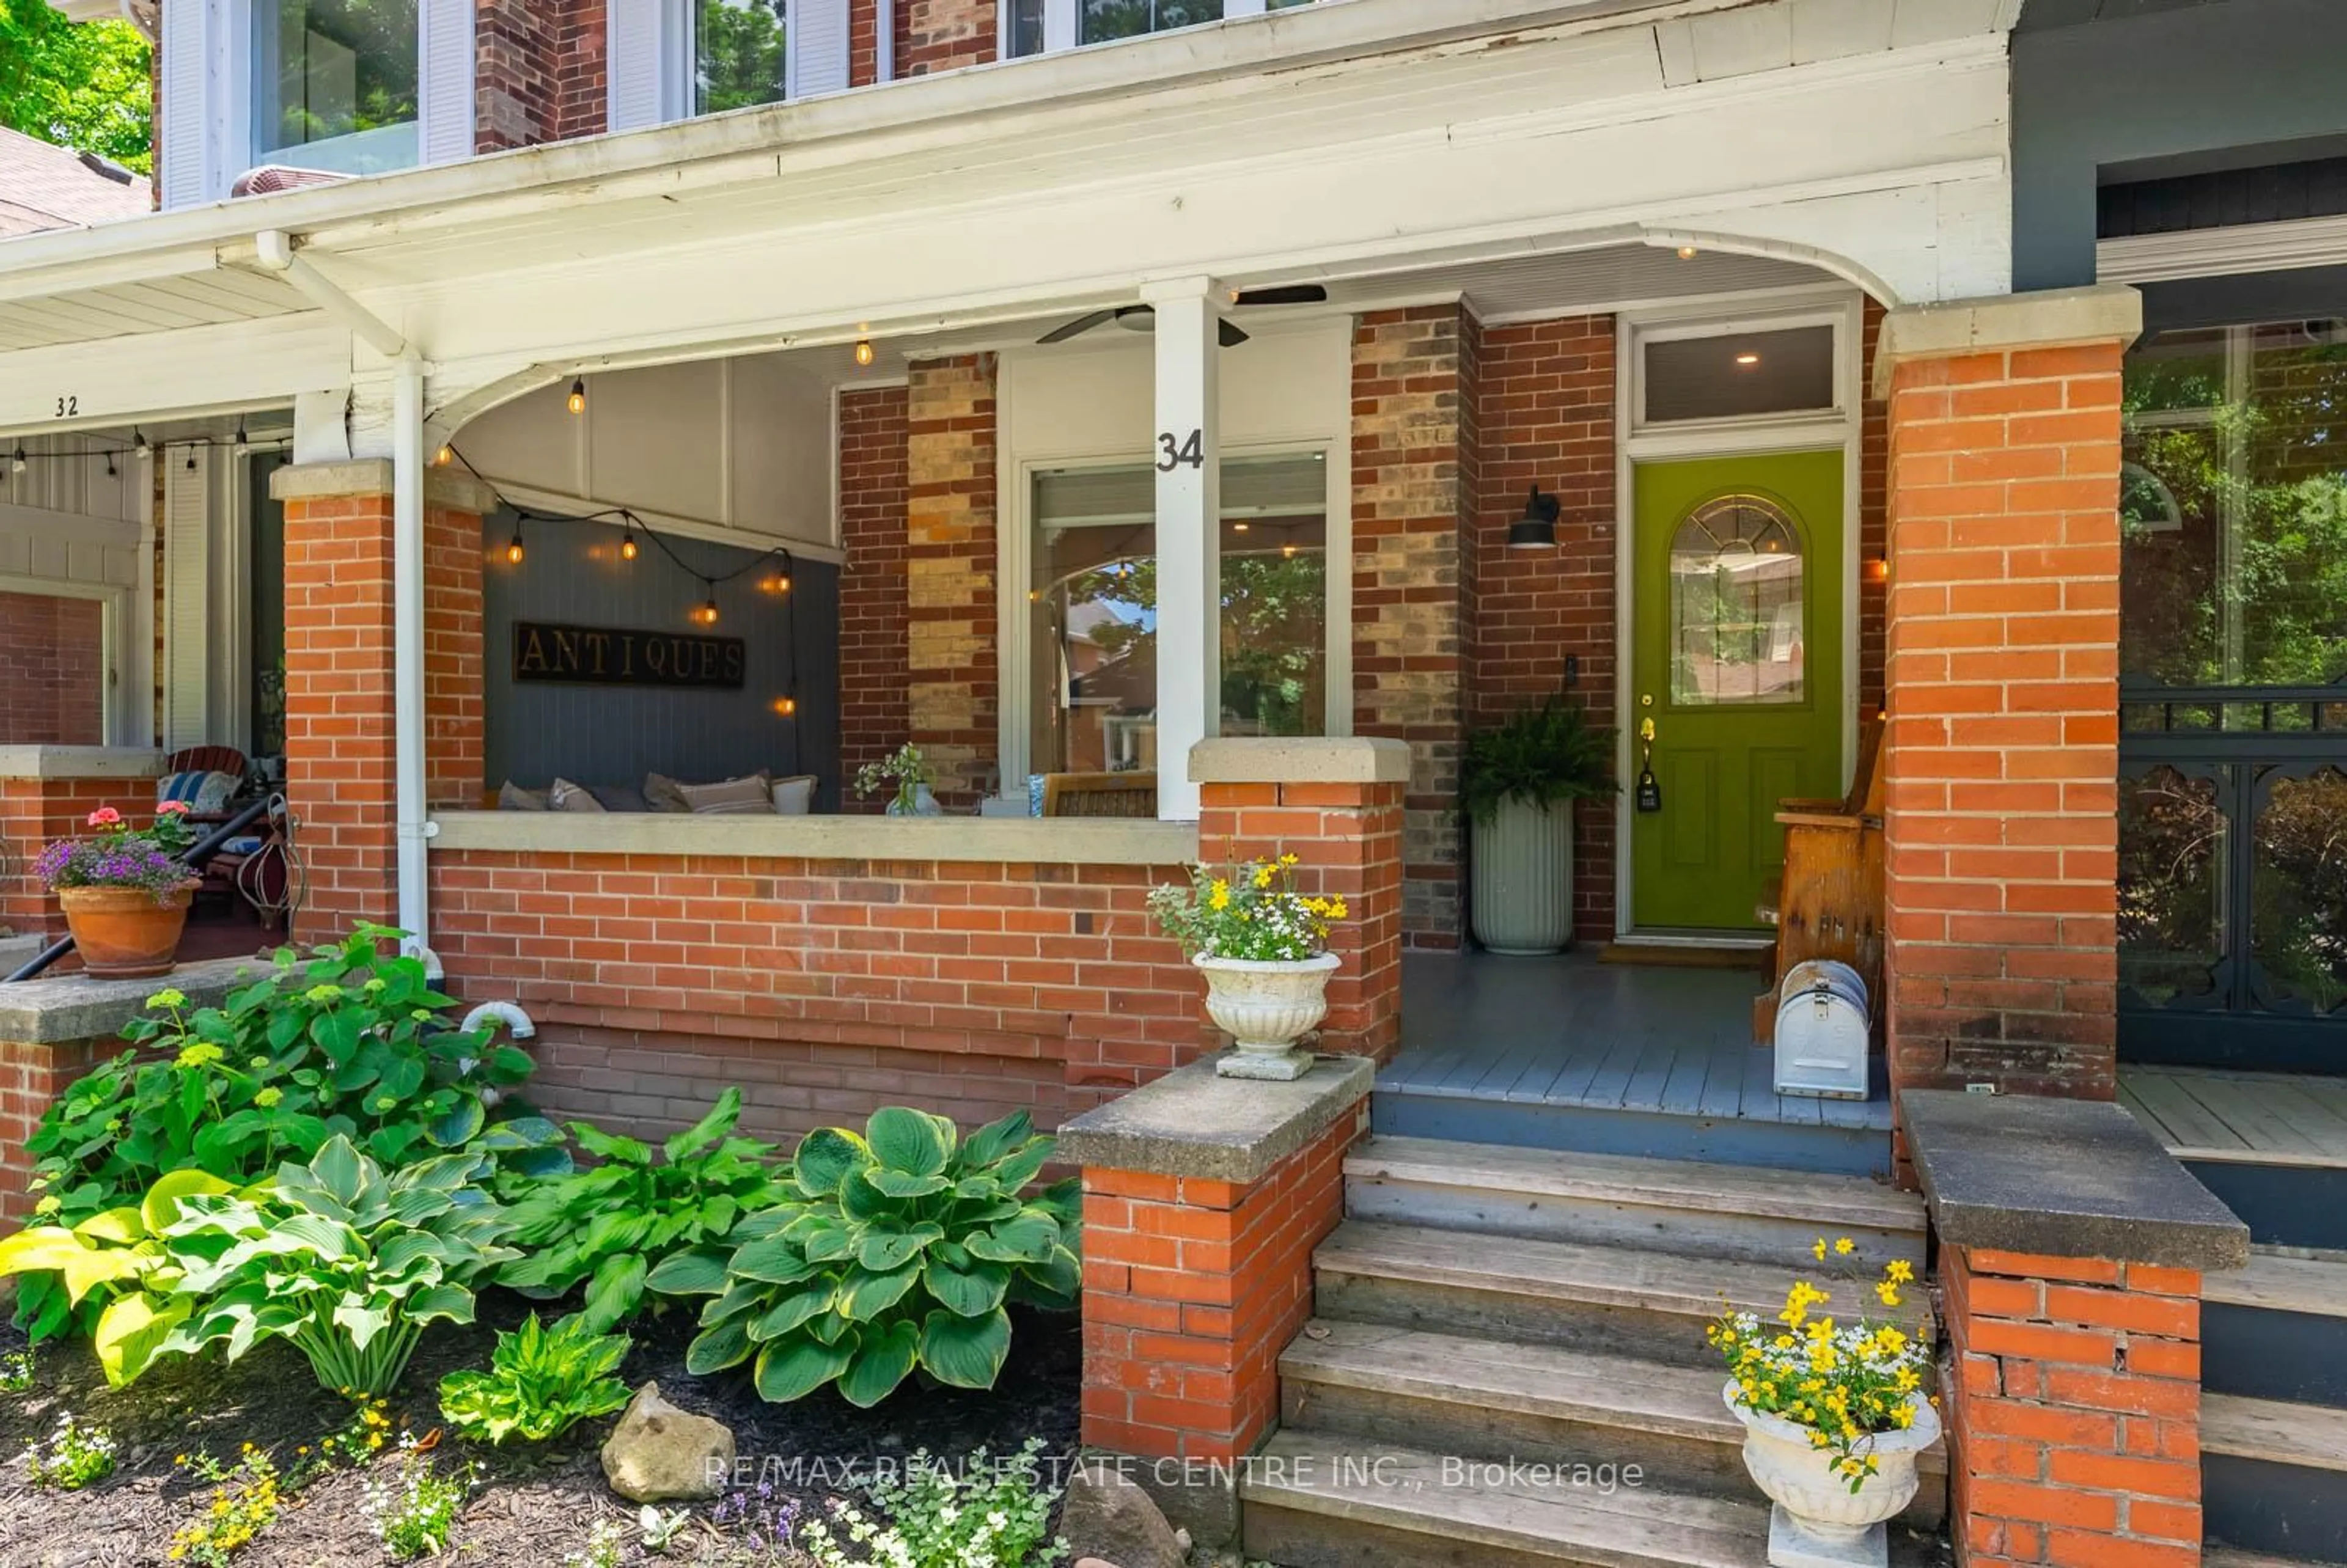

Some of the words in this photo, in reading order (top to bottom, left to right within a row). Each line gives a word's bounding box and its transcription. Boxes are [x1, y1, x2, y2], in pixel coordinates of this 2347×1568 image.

[56, 395, 78, 417] 32
[1157, 429, 1203, 471] 34
[521, 629, 741, 681] ANTIQUES
